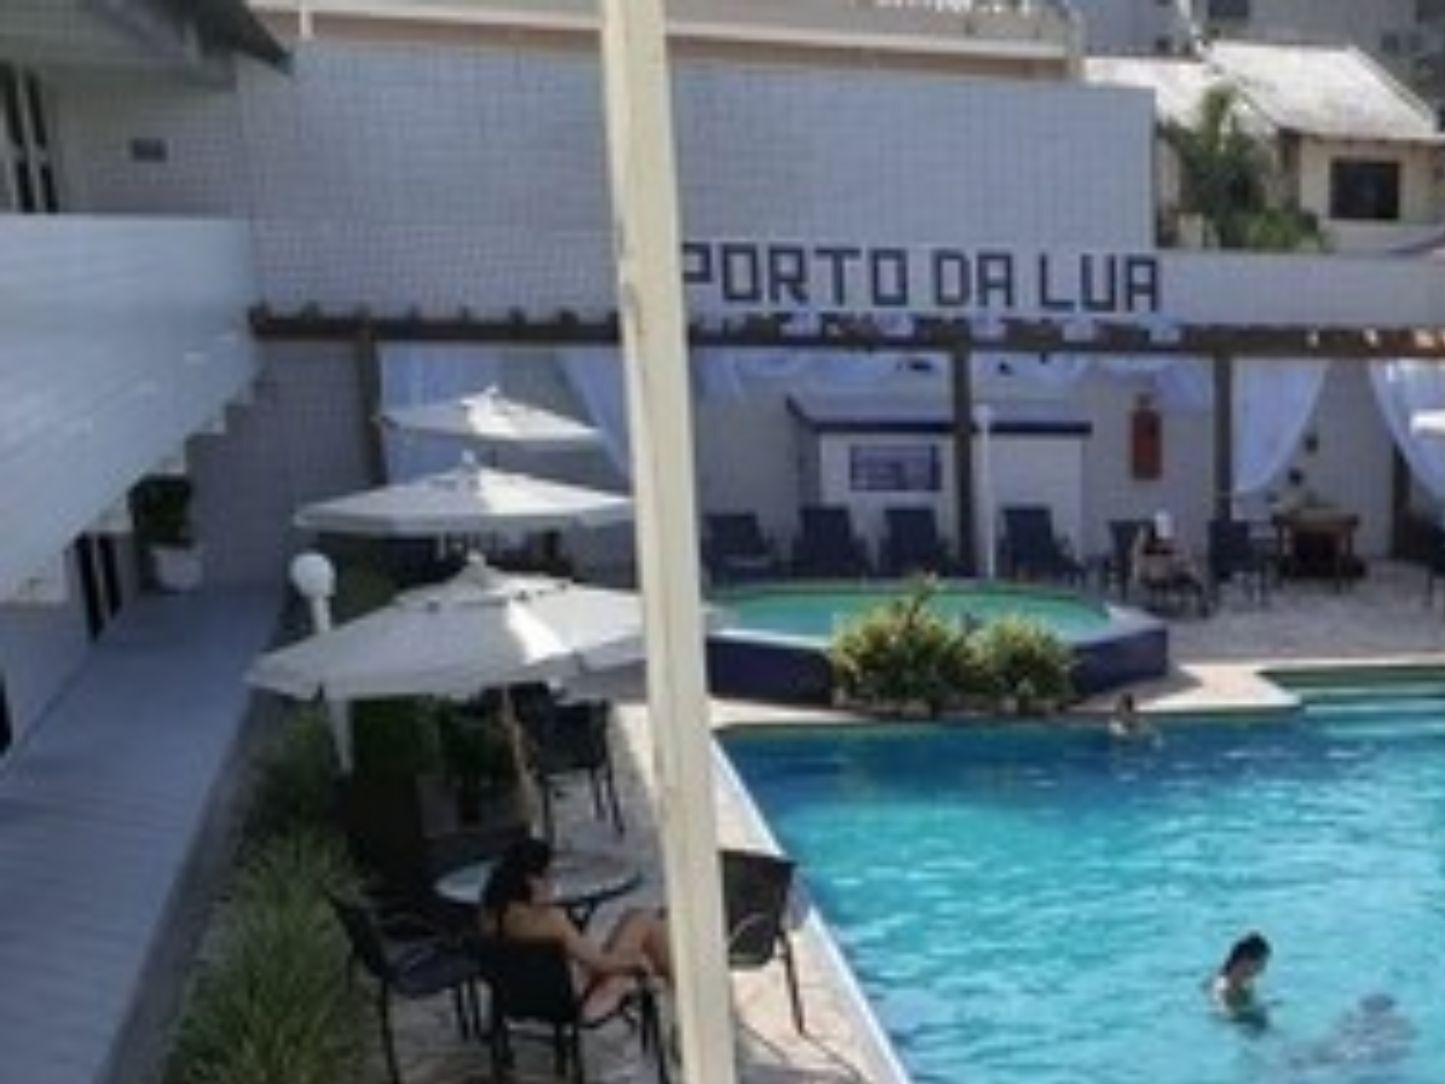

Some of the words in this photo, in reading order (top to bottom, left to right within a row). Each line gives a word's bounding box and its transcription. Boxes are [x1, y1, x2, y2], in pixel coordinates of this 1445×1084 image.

[683, 242, 908, 307] PORTO
[934, 250, 1013, 307] DA
[1039, 253, 1158, 312] LUA
